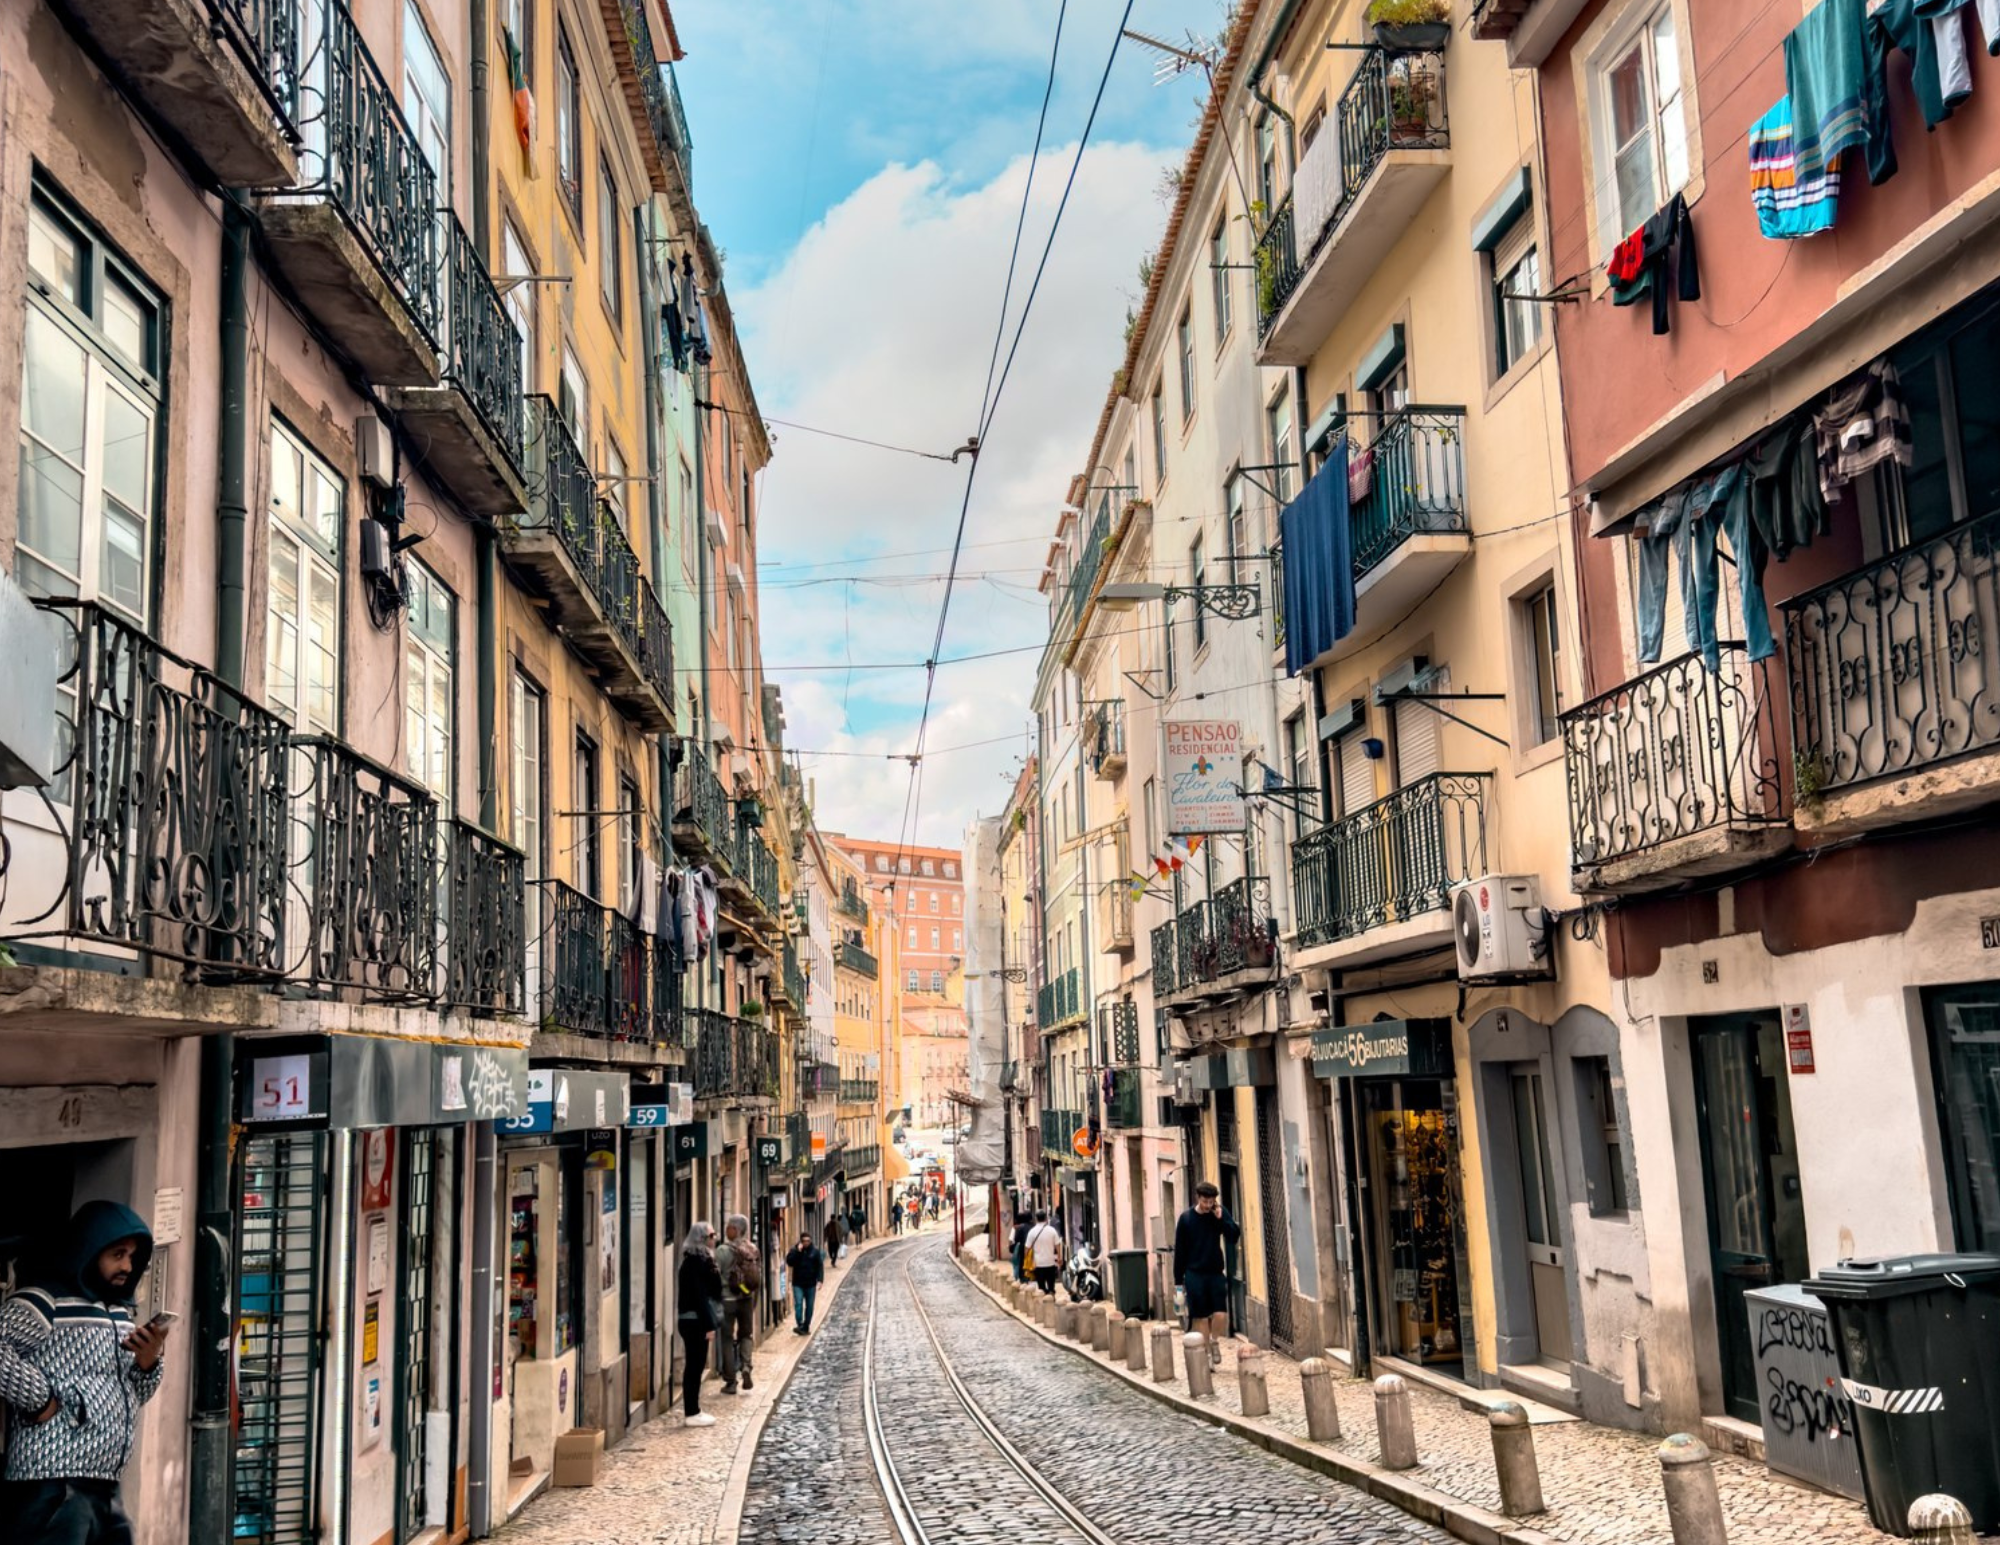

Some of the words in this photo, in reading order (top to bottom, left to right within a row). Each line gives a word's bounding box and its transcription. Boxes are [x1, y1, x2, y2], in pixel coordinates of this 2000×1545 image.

[1169, 743, 1236, 755] RESIDENCIAL
[1173, 773, 1210, 792] Flor
[1348, 1032, 1366, 1067] 56
[262, 1076, 303, 1107] 51
[505, 1108, 535, 1129] 55
[636, 1108, 657, 1124] 59
[681, 1136, 695, 1148] 61
[761, 1143, 776, 1158] 69
